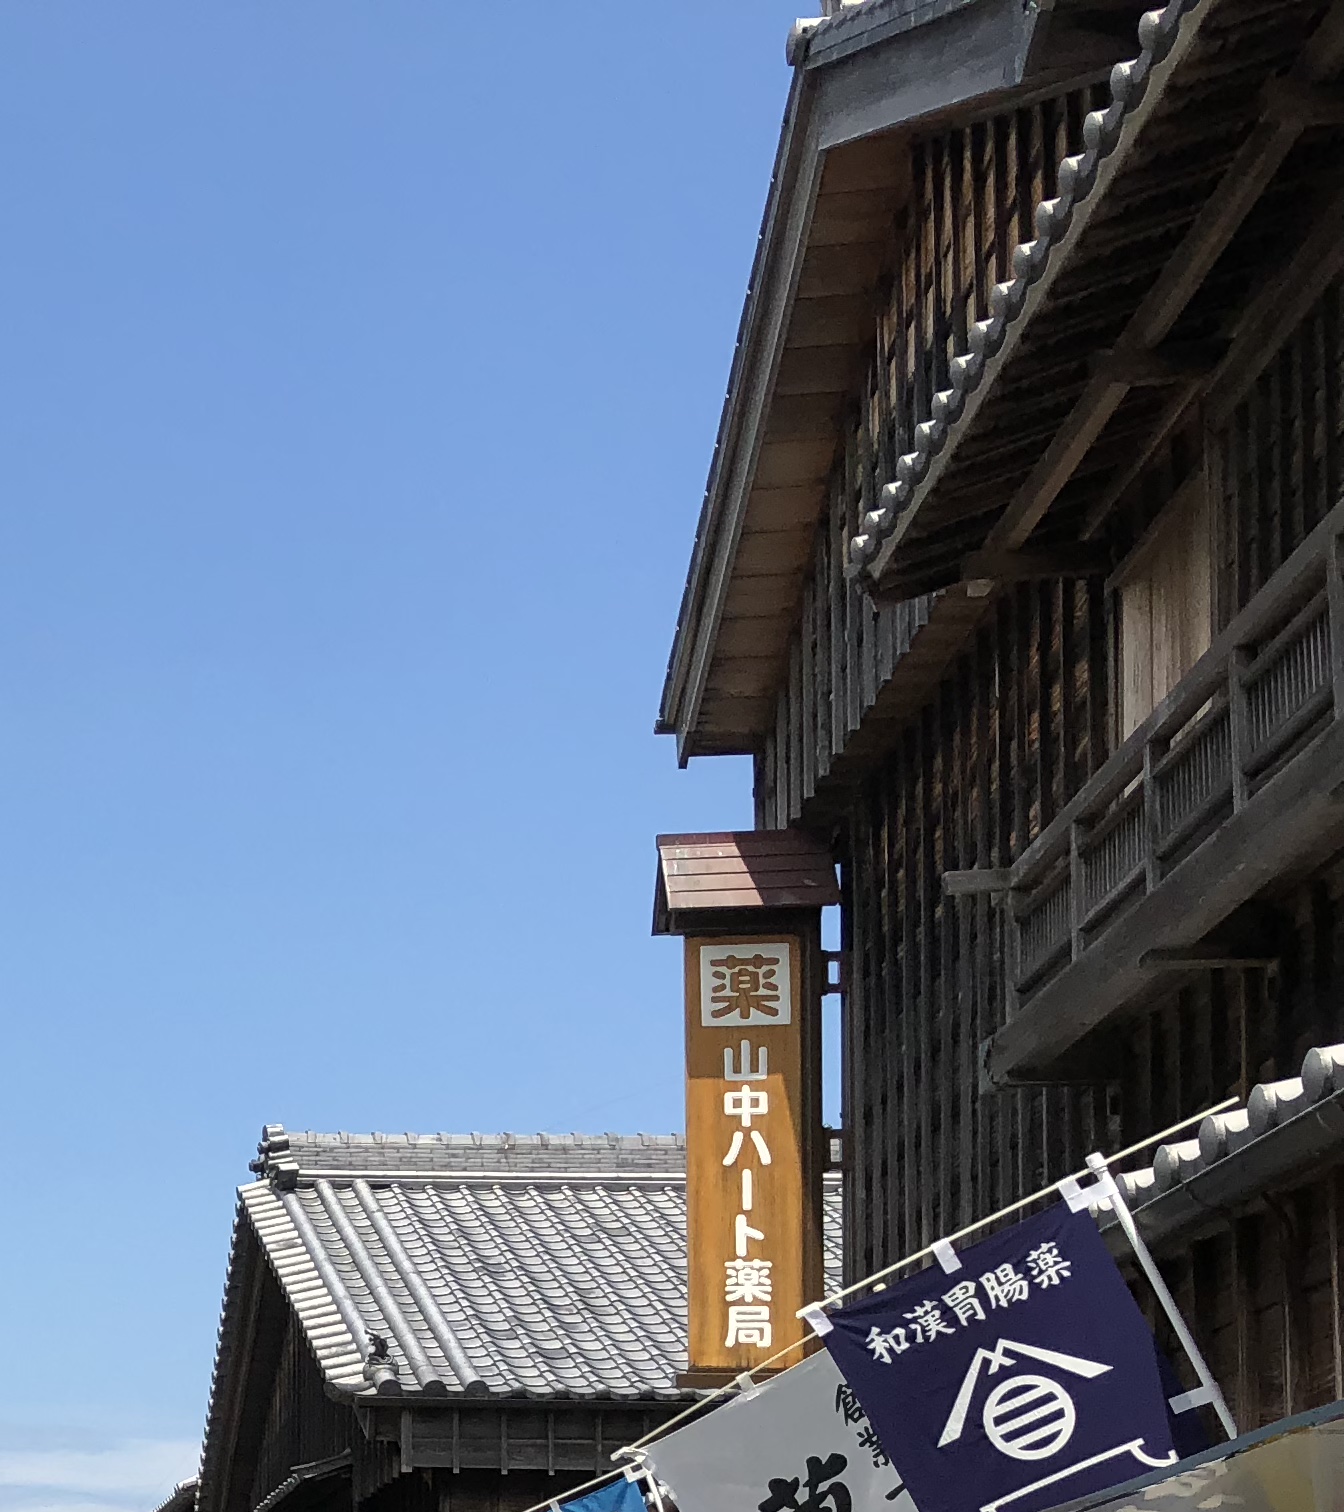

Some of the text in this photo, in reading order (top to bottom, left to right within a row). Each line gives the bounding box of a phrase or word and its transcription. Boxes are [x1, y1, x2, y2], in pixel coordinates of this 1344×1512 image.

[709, 954, 781, 1019] 薬
[722, 1039, 773, 1348] 山中ハート薬局
[868, 1243, 1074, 1364] 和漢胃腸薬
